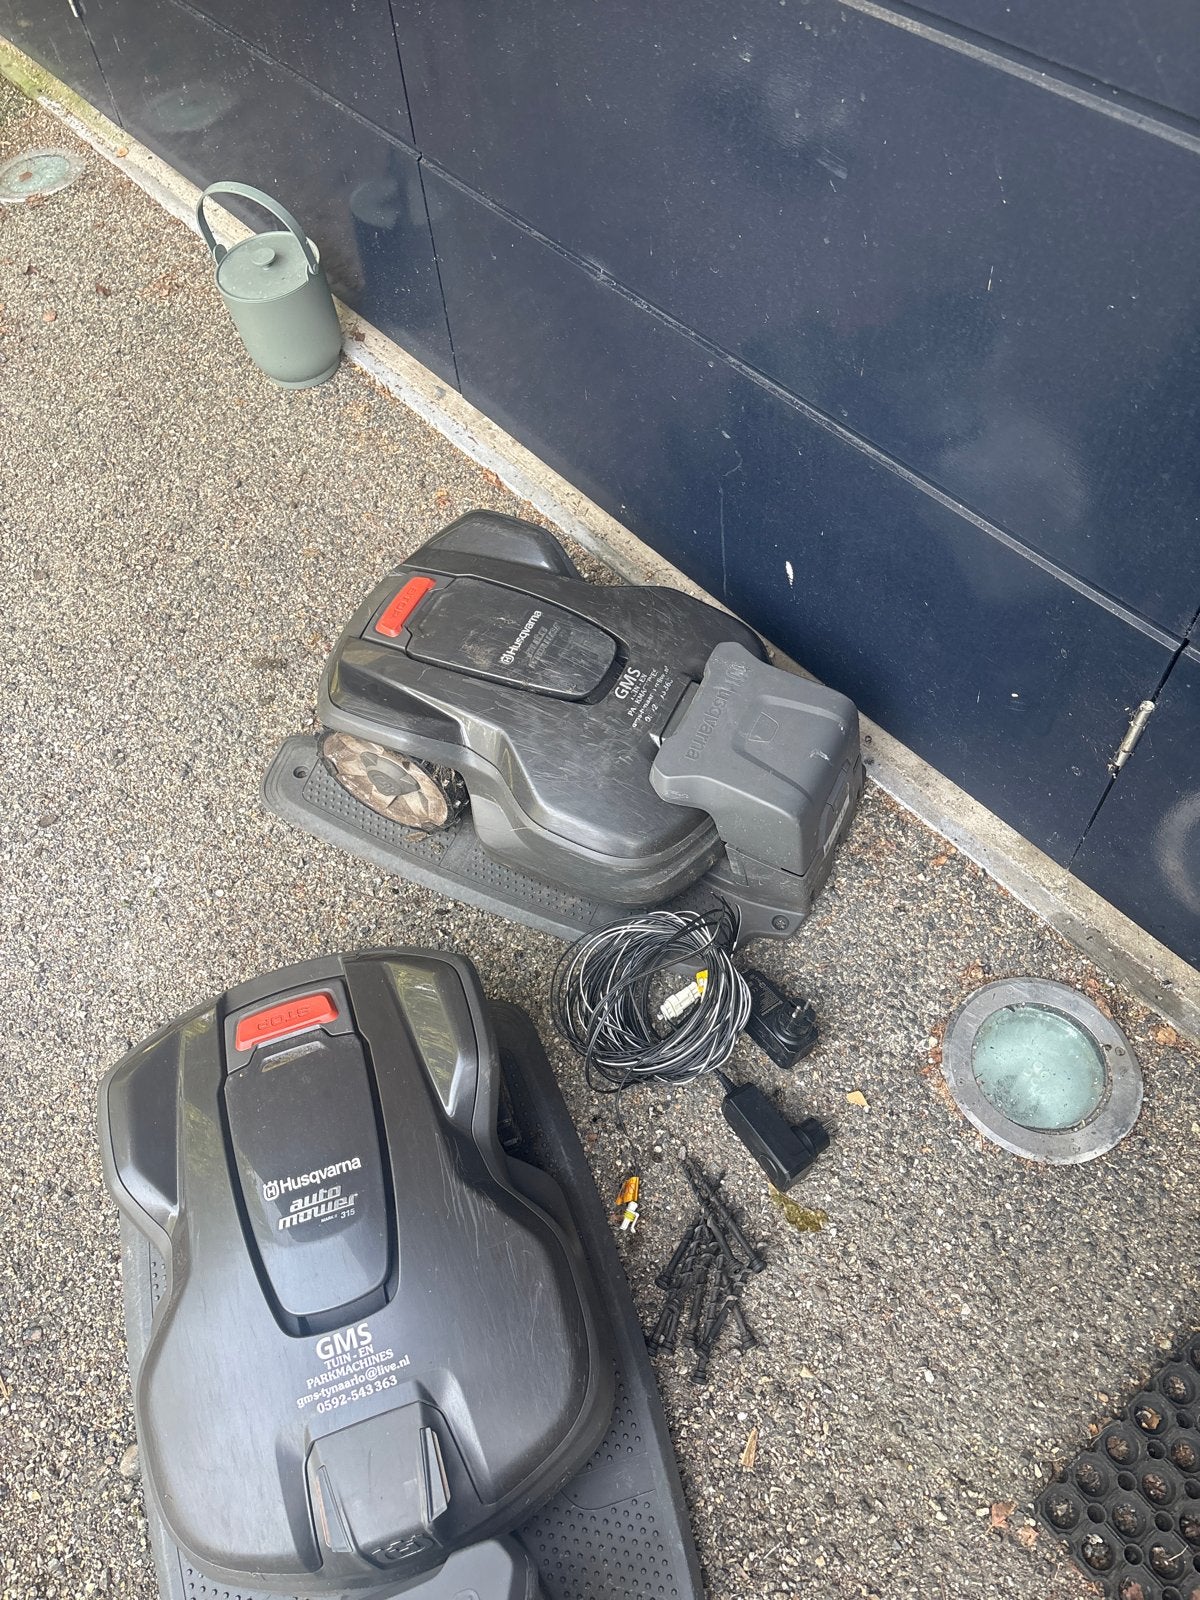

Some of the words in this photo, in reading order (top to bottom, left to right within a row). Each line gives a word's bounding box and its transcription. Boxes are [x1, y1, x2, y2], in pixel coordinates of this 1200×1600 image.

[506, 610, 542, 656] Husqvarna
[614, 666, 641, 700] GMS
[257, 1006, 311, 1031] STOP
[280, 1157, 362, 1194] Husqvarna
[278, 1193, 358, 1231] mower
[290, 1185, 342, 1213] auto
[340, 1208, 356, 1219] 315
[316, 1322, 373, 1360] GMS
[323, 1352, 352, 1370] TUIN
[358, 1344, 375, 1358] EN
[296, 1354, 411, 1409] gms-tynaarlo@live.nl
[306, 1348, 395, 1390] PARKMACHINES
